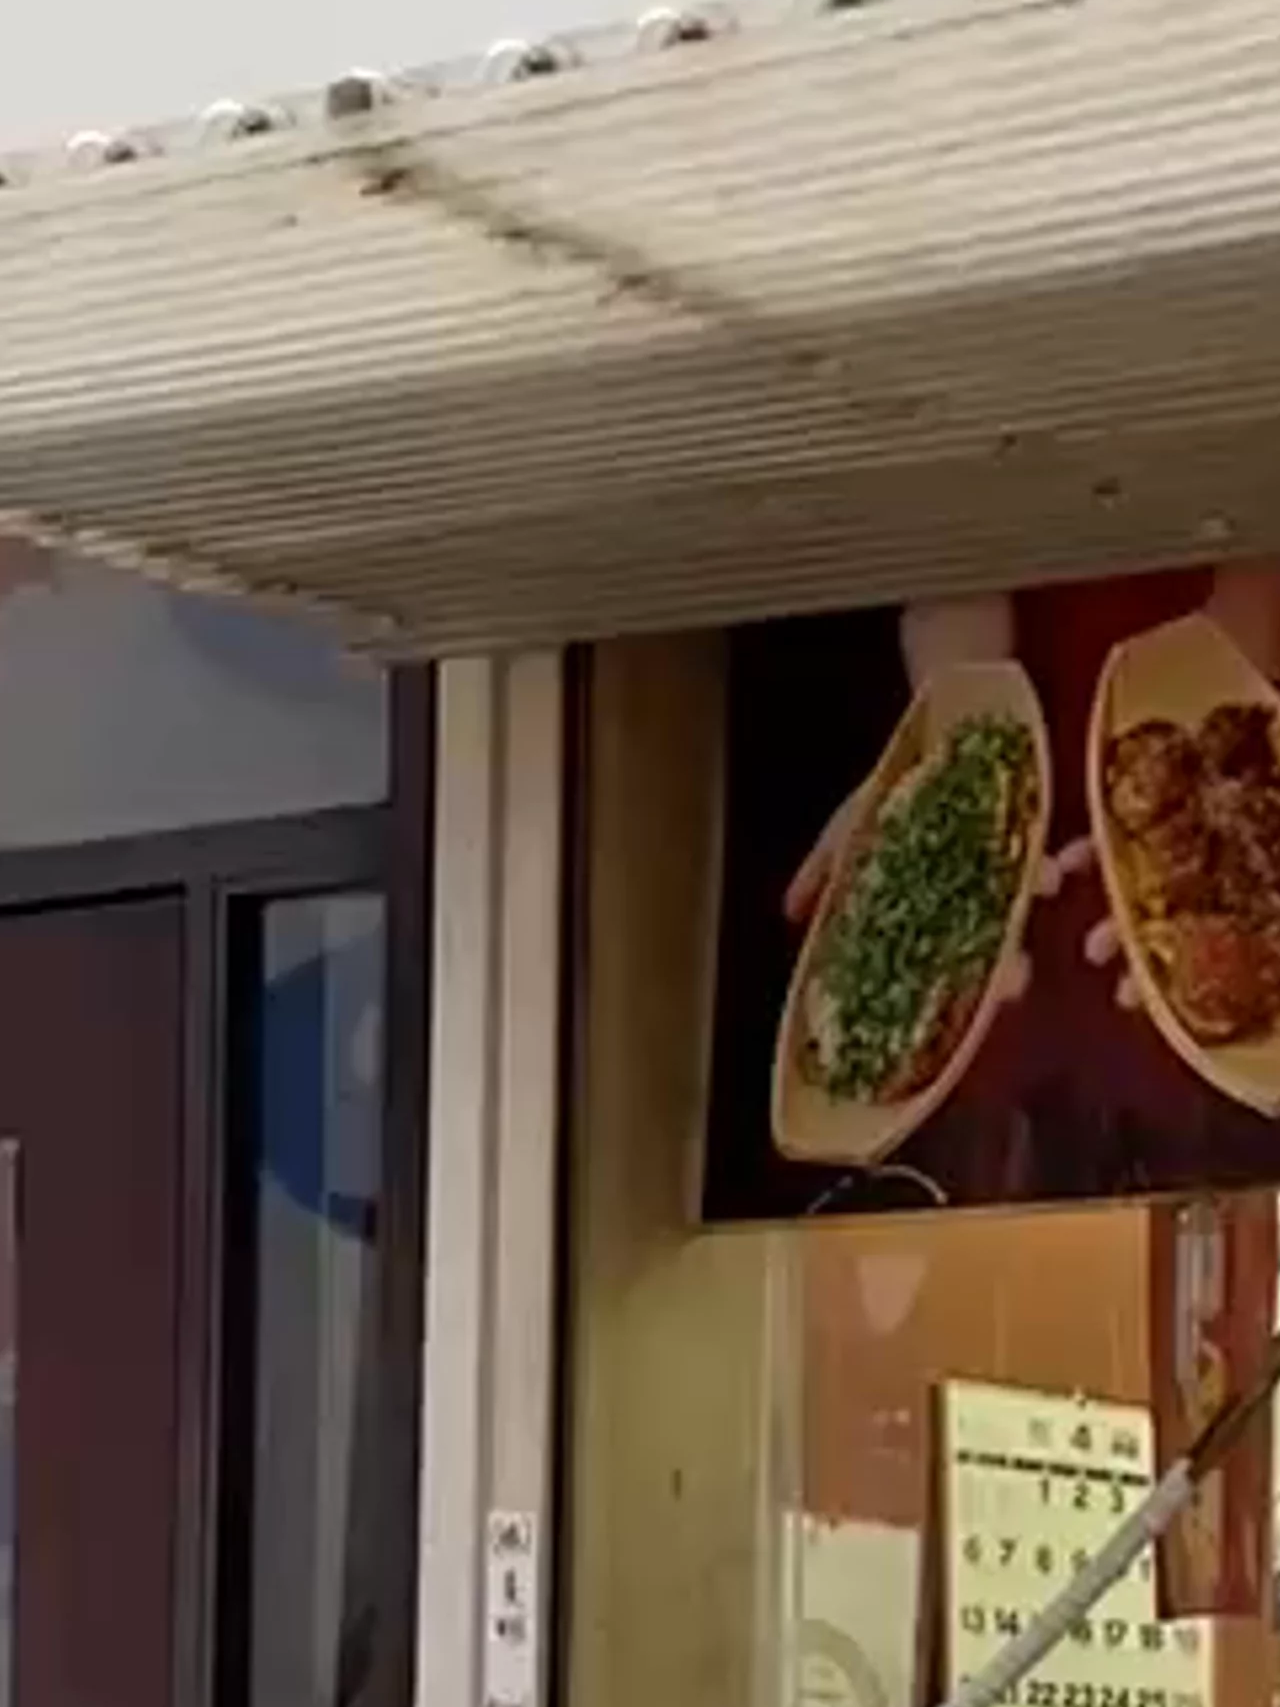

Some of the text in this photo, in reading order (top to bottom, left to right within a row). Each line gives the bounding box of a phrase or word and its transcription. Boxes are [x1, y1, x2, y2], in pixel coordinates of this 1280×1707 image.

[1072, 1481, 1090, 1509] 2
[998, 1539, 1017, 1566] 7
[995, 1608, 1020, 1636] 14
[1026, 1679, 1058, 1707] 22
